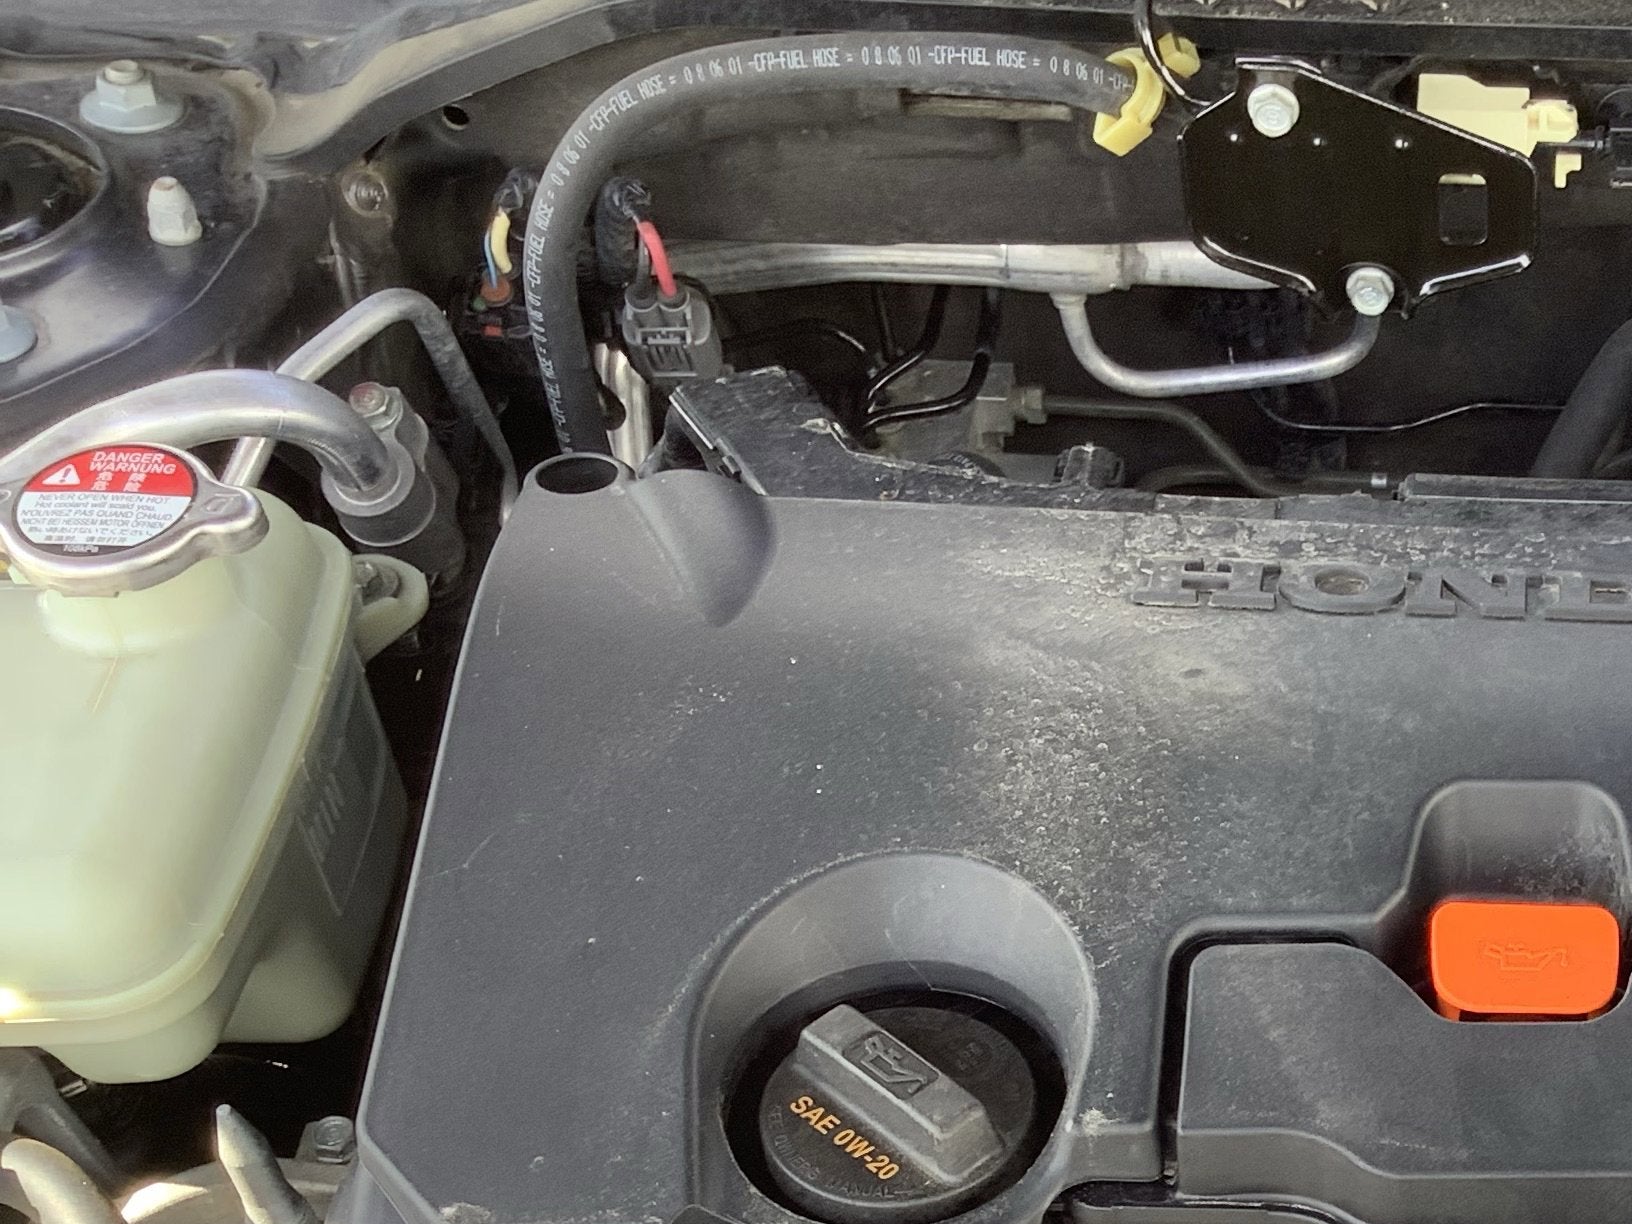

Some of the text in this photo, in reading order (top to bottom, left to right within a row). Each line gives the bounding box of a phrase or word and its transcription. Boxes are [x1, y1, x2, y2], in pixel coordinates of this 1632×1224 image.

[636, 74, 667, 101] HOSE
[728, 56, 744, 76] 01
[812, 47, 841, 67] HOSE
[908, 45, 921, 66] 01
[996, 50, 1027, 70] HOSE
[93, 451, 165, 464] DANGER
[89, 461, 177, 475] WARNUNG
[38, 493, 171, 505] NEVER OPEN WHEN HOT
[34, 501, 52, 509] Hot
[54, 501, 90, 510] coolant
[92, 502, 108, 510] will
[109, 502, 135, 510] scald
[73, 509, 95, 518] PAS
[96, 510, 133, 519] QUAND
[99, 518, 131, 528] MOTOR
[789, 1095, 900, 1180] SAE 0W-20
